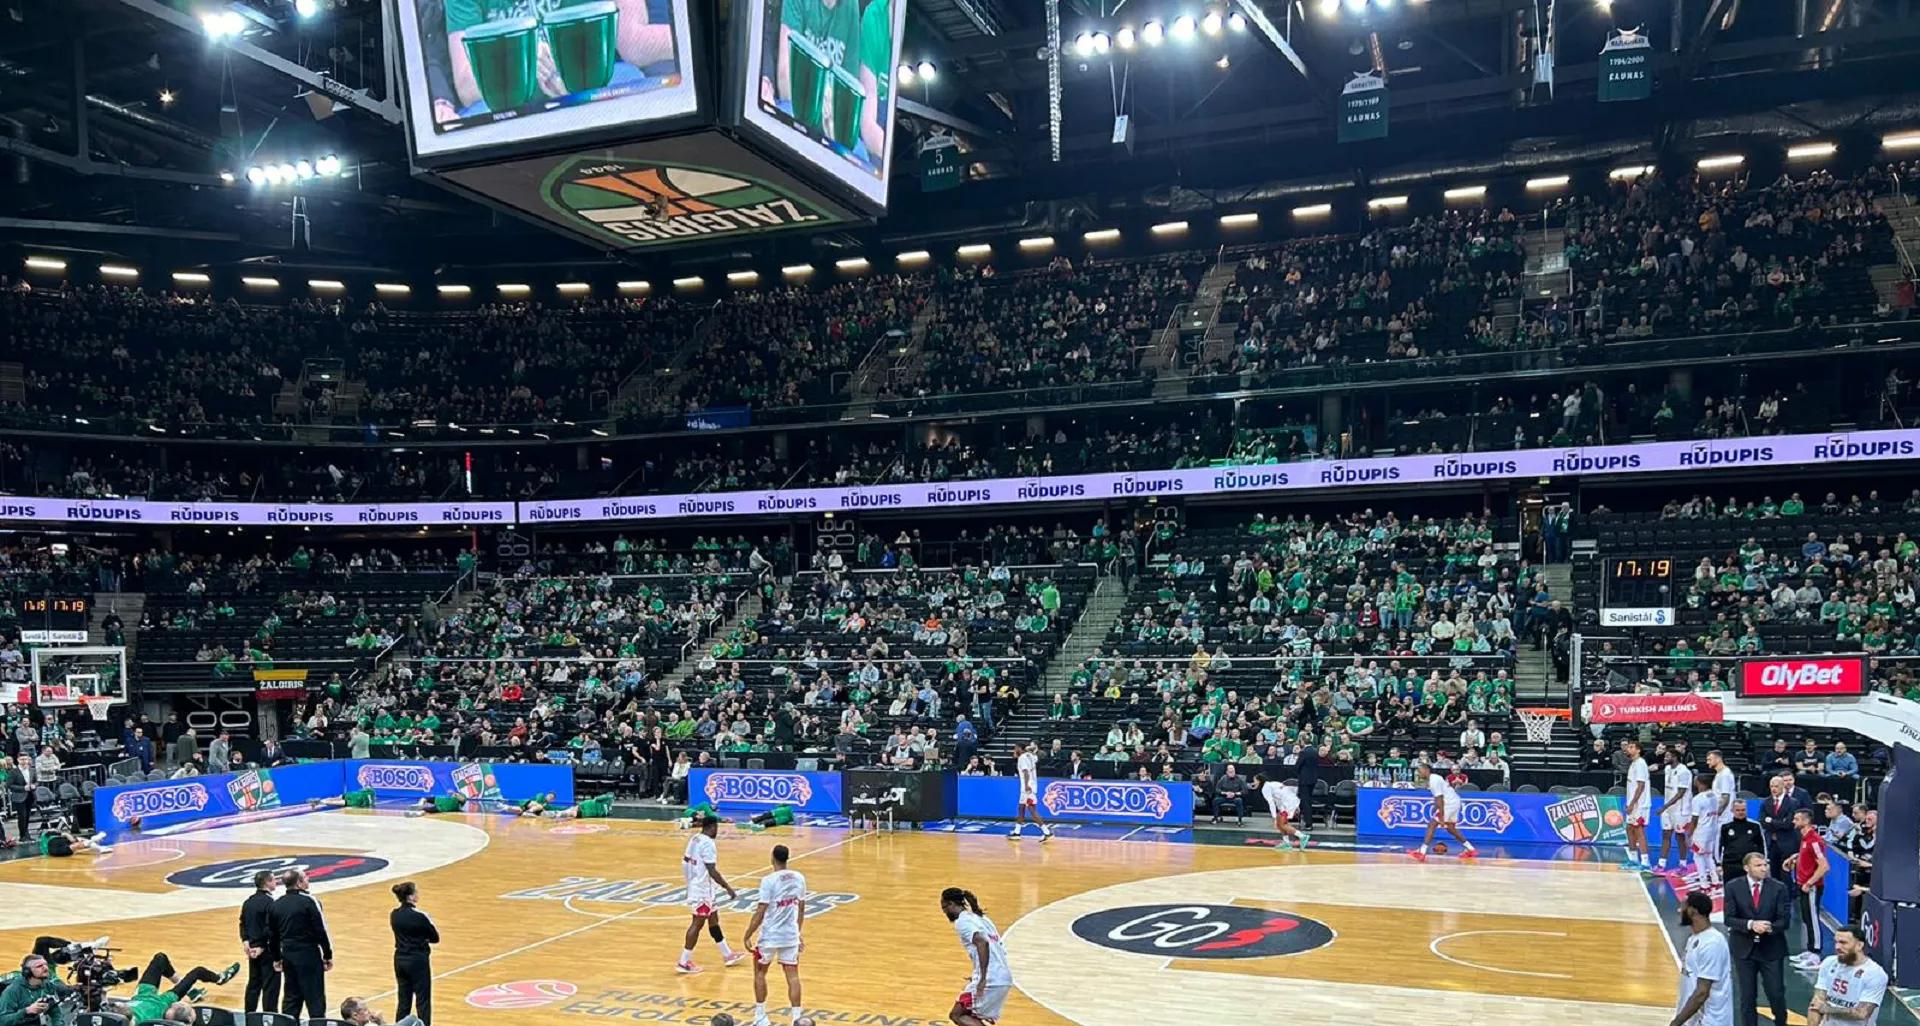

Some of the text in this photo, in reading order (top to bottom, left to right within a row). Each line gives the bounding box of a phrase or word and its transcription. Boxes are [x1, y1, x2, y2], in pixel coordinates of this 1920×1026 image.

[935, 149, 943, 165] 5
[0, 505, 36, 517] UPIS
[1760, 663, 1844, 691] OlyBet
[1619, 703, 1698, 715] TURKISH AIRLINES
[373, 769, 419, 786] BOSO
[724, 777, 792, 799] BOSO
[131, 788, 188, 812] BOSO
[1066, 786, 1147, 811] BOSO
[1403, 800, 1487, 825] BOO
[1832, 978, 1849, 995] 55
